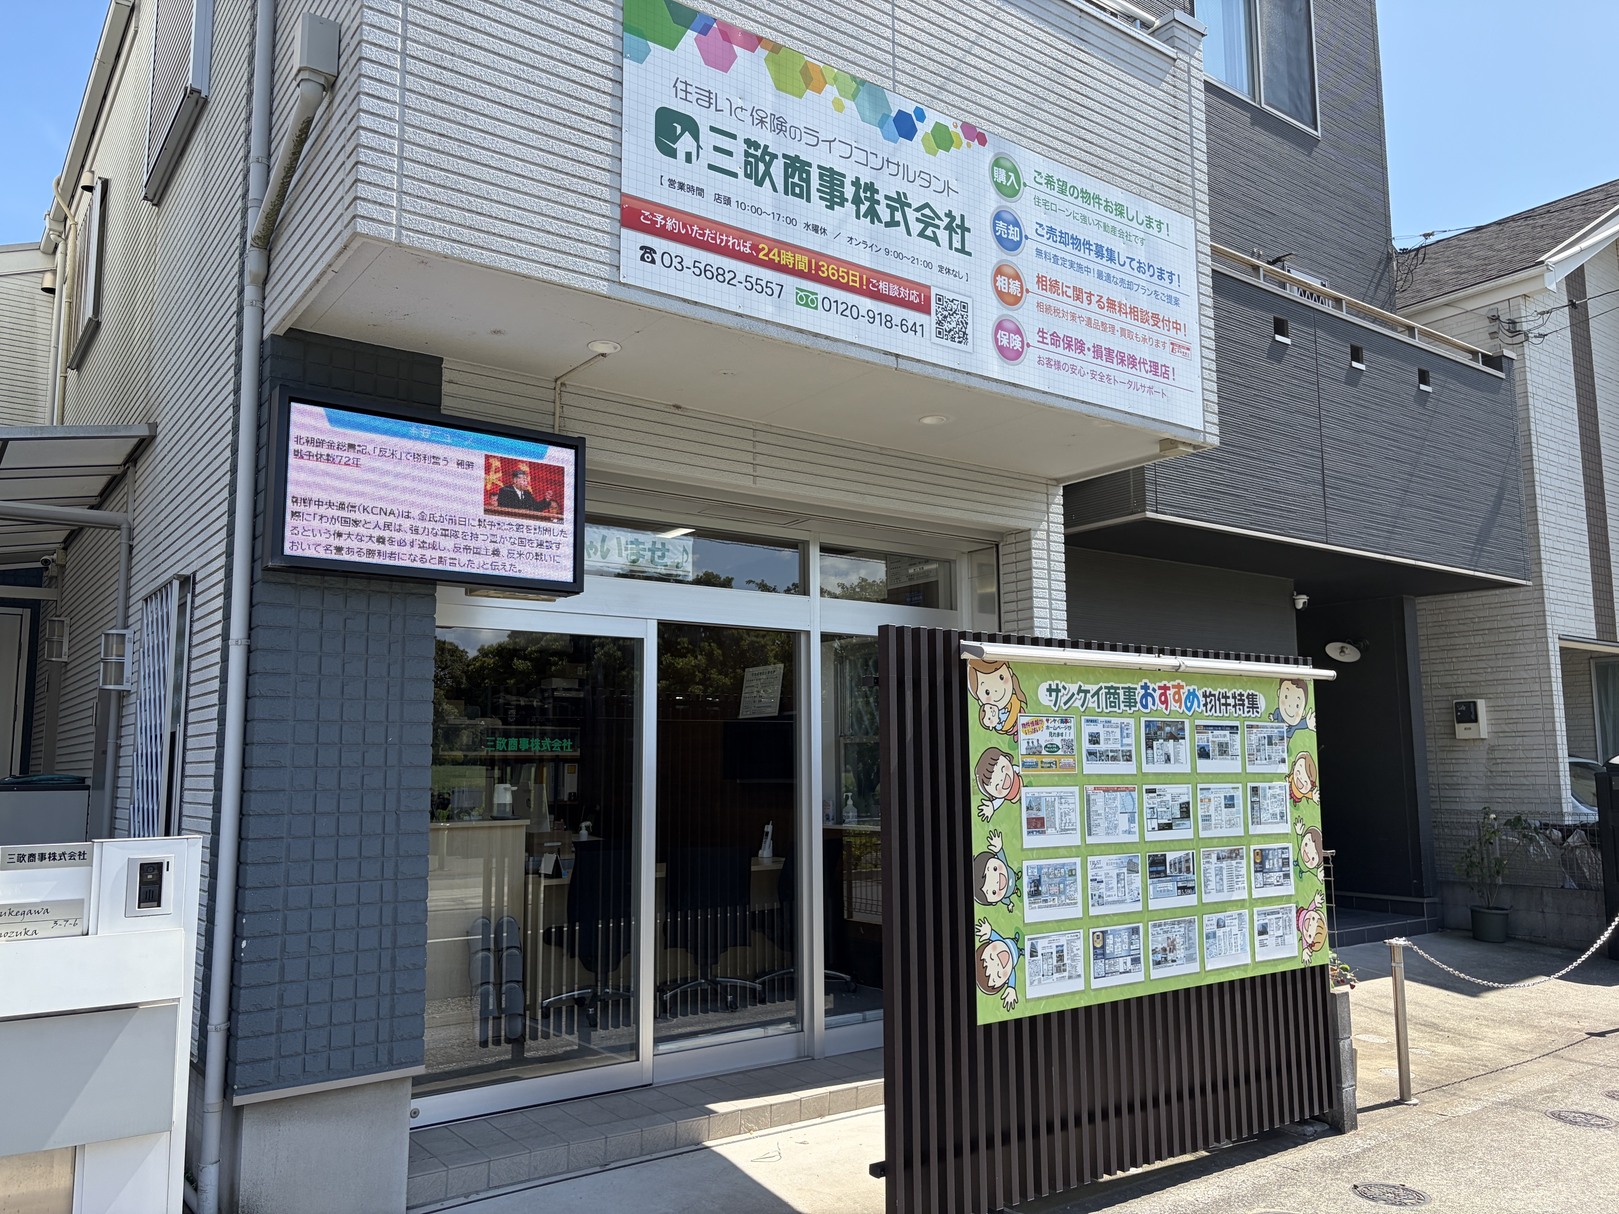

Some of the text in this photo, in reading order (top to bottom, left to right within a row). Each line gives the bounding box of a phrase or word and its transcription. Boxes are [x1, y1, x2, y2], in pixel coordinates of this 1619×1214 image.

[673, 77, 959, 197] 住まいと保険のライフコンサルタント
[707, 125, 973, 257] 三敬商事株式会社
[993, 166, 1019, 190] 購入
[713, 192, 732, 208] 店頭
[803, 221, 828, 237] 水曜休
[846, 235, 882, 253] オンライン
[1033, 169, 1170, 237] ご希望の物件お探しします！
[1033, 194, 1146, 247] 住宅ローンに強い不動産会社です
[995, 220, 1020, 242] 売却
[660, 251, 785, 299] 03-5682-5557
[1035, 221, 1182, 288] ご売却物件募集しております！
[995, 274, 1021, 297] 相続
[1035, 273, 1188, 338] 相続に関する無料相談受付中！
[821, 296, 925, 338] 0120-918-641
[996, 329, 1022, 352] 保険
[1036, 327, 1177, 382] 生命保険・損害保険代理店！
[1036, 354, 1168, 399] お客様の安心・安全をトータルサポート
[1045, 681, 1261, 716] サンケイ商事おすすめ物件特集
[486, 737, 573, 752] 三敬商事株式会社
[7, 850, 88, 865] 三敬商事株式会社
[0, 927, 39, 939] ozuka
